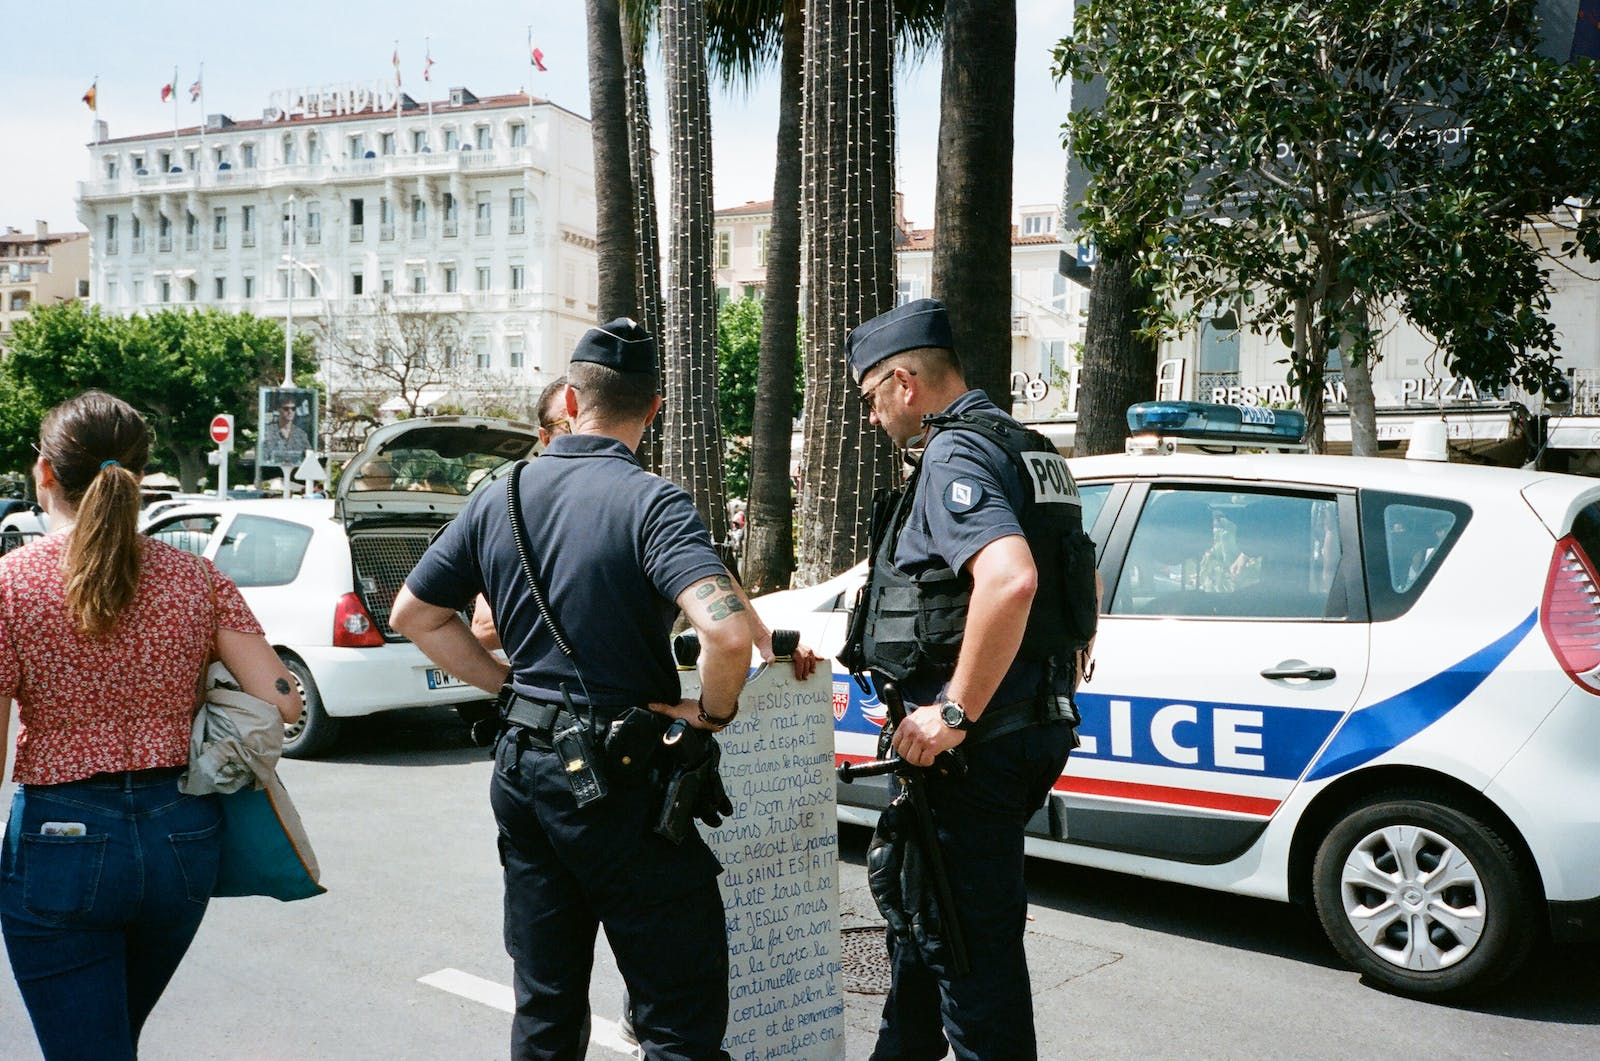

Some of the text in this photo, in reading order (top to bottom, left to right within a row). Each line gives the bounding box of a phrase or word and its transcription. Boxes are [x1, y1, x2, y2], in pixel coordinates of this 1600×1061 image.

[267, 80, 398, 122] SPLENDID
[1400, 377, 1477, 401] PIZZA
[1242, 406, 1274, 423] POLICE
[754, 734, 766, 752] et
[755, 757, 780, 774] dans
[707, 823, 761, 844] moins
[724, 868, 744, 887] du
[746, 906, 790, 936] JESUS
[794, 898, 828, 916] nous
[806, 920, 832, 937] son
[748, 956, 765, 975] la
[766, 1020, 779, 1036] et
[782, 1015, 794, 1032] de
